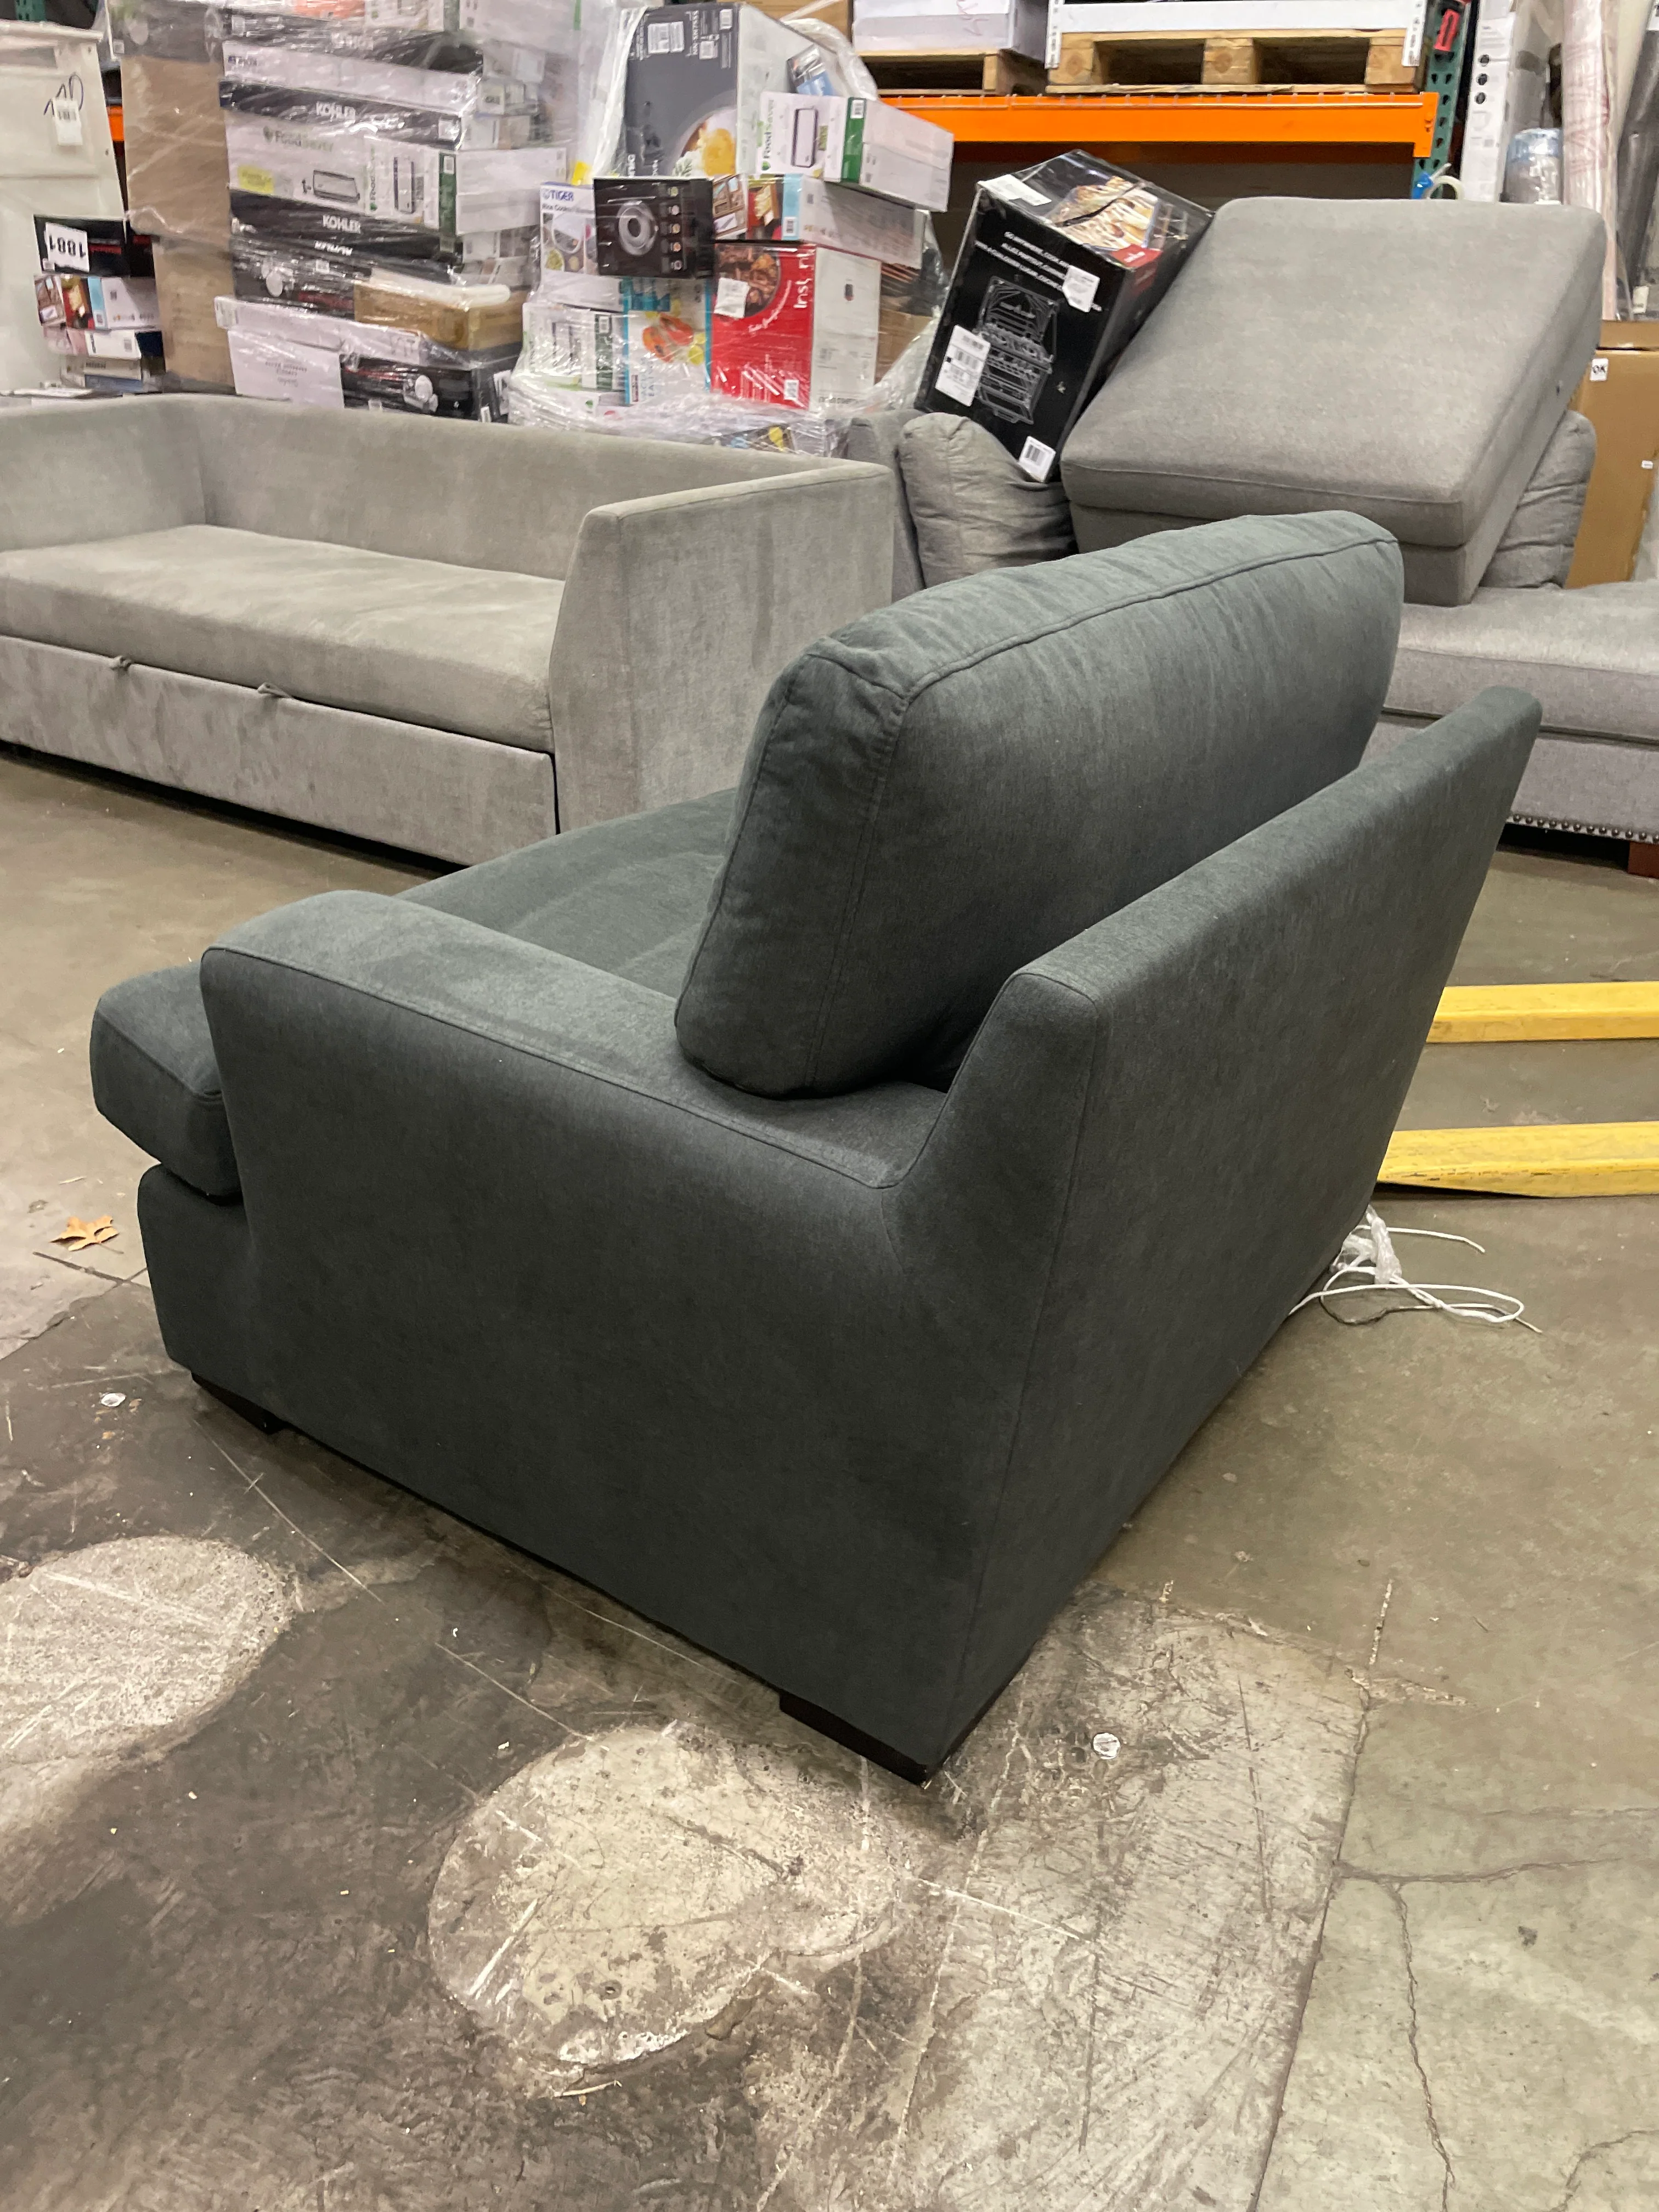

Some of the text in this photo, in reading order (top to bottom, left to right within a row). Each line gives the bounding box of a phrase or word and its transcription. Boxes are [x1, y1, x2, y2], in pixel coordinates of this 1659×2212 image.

[549, 189, 574, 202] TIGER
[323, 215, 361, 234] KOHLER
[49, 234, 87, 258] 1881
[1592, 364, 1607, 375] OK
